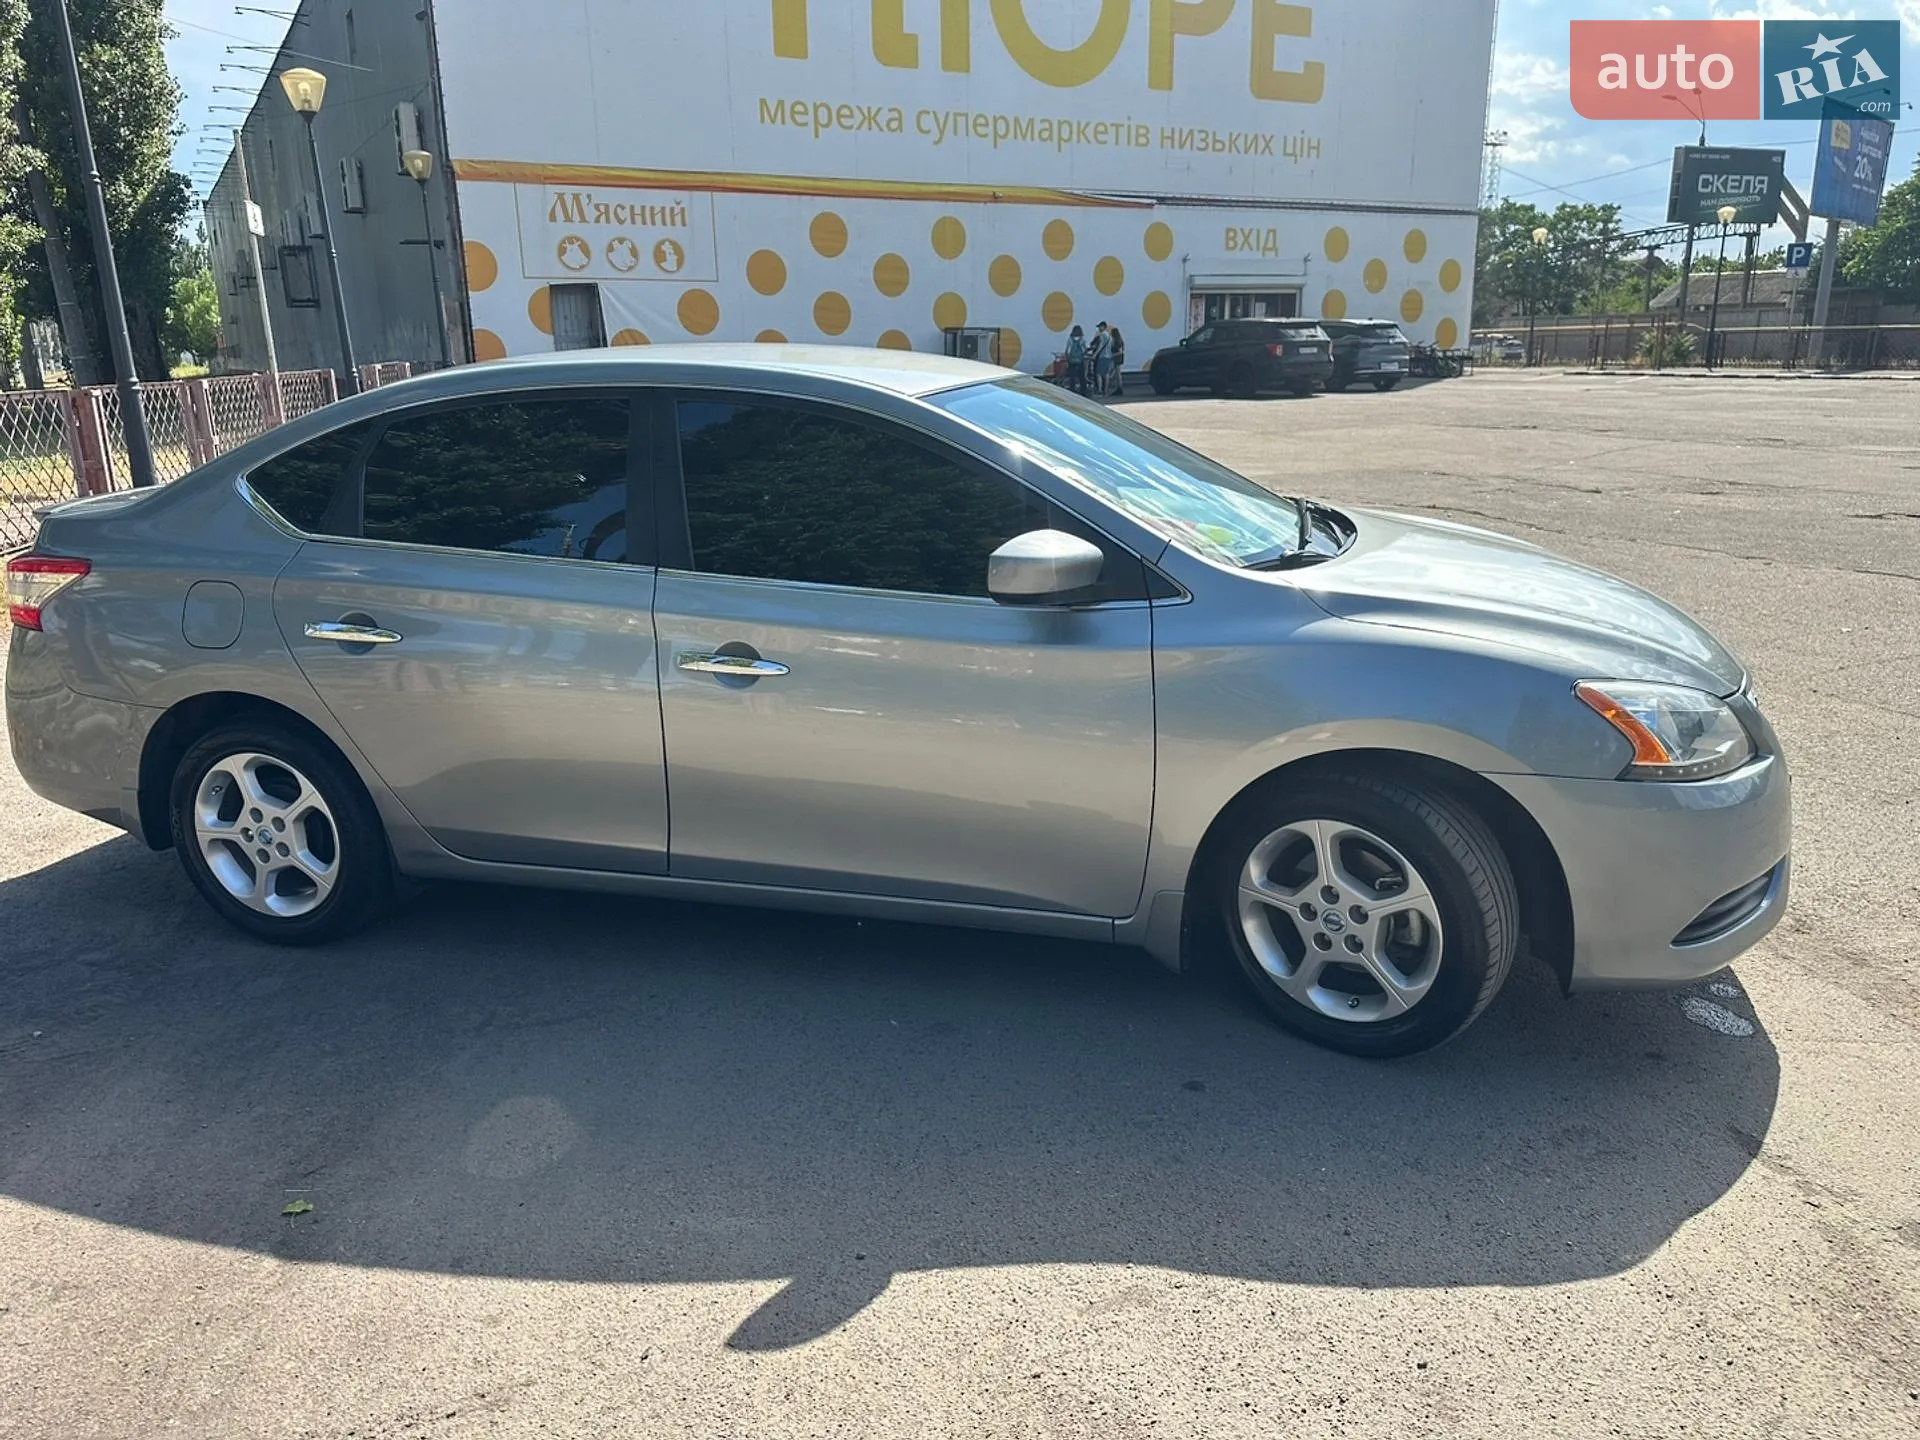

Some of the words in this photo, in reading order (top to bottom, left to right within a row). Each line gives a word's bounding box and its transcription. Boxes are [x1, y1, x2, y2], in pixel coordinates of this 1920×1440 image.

[758, 97, 903, 139] мережа
[915, 108, 1151, 153] супермаркетів
[1160, 126, 1275, 157] низьких
[1282, 130, 1322, 165] цін
[1697, 173, 1769, 195] СКЕЛЯ
[548, 191, 688, 228] М'ясний
[1224, 227, 1279, 258] ВХІД
[1791, 246, 1806, 265] P
